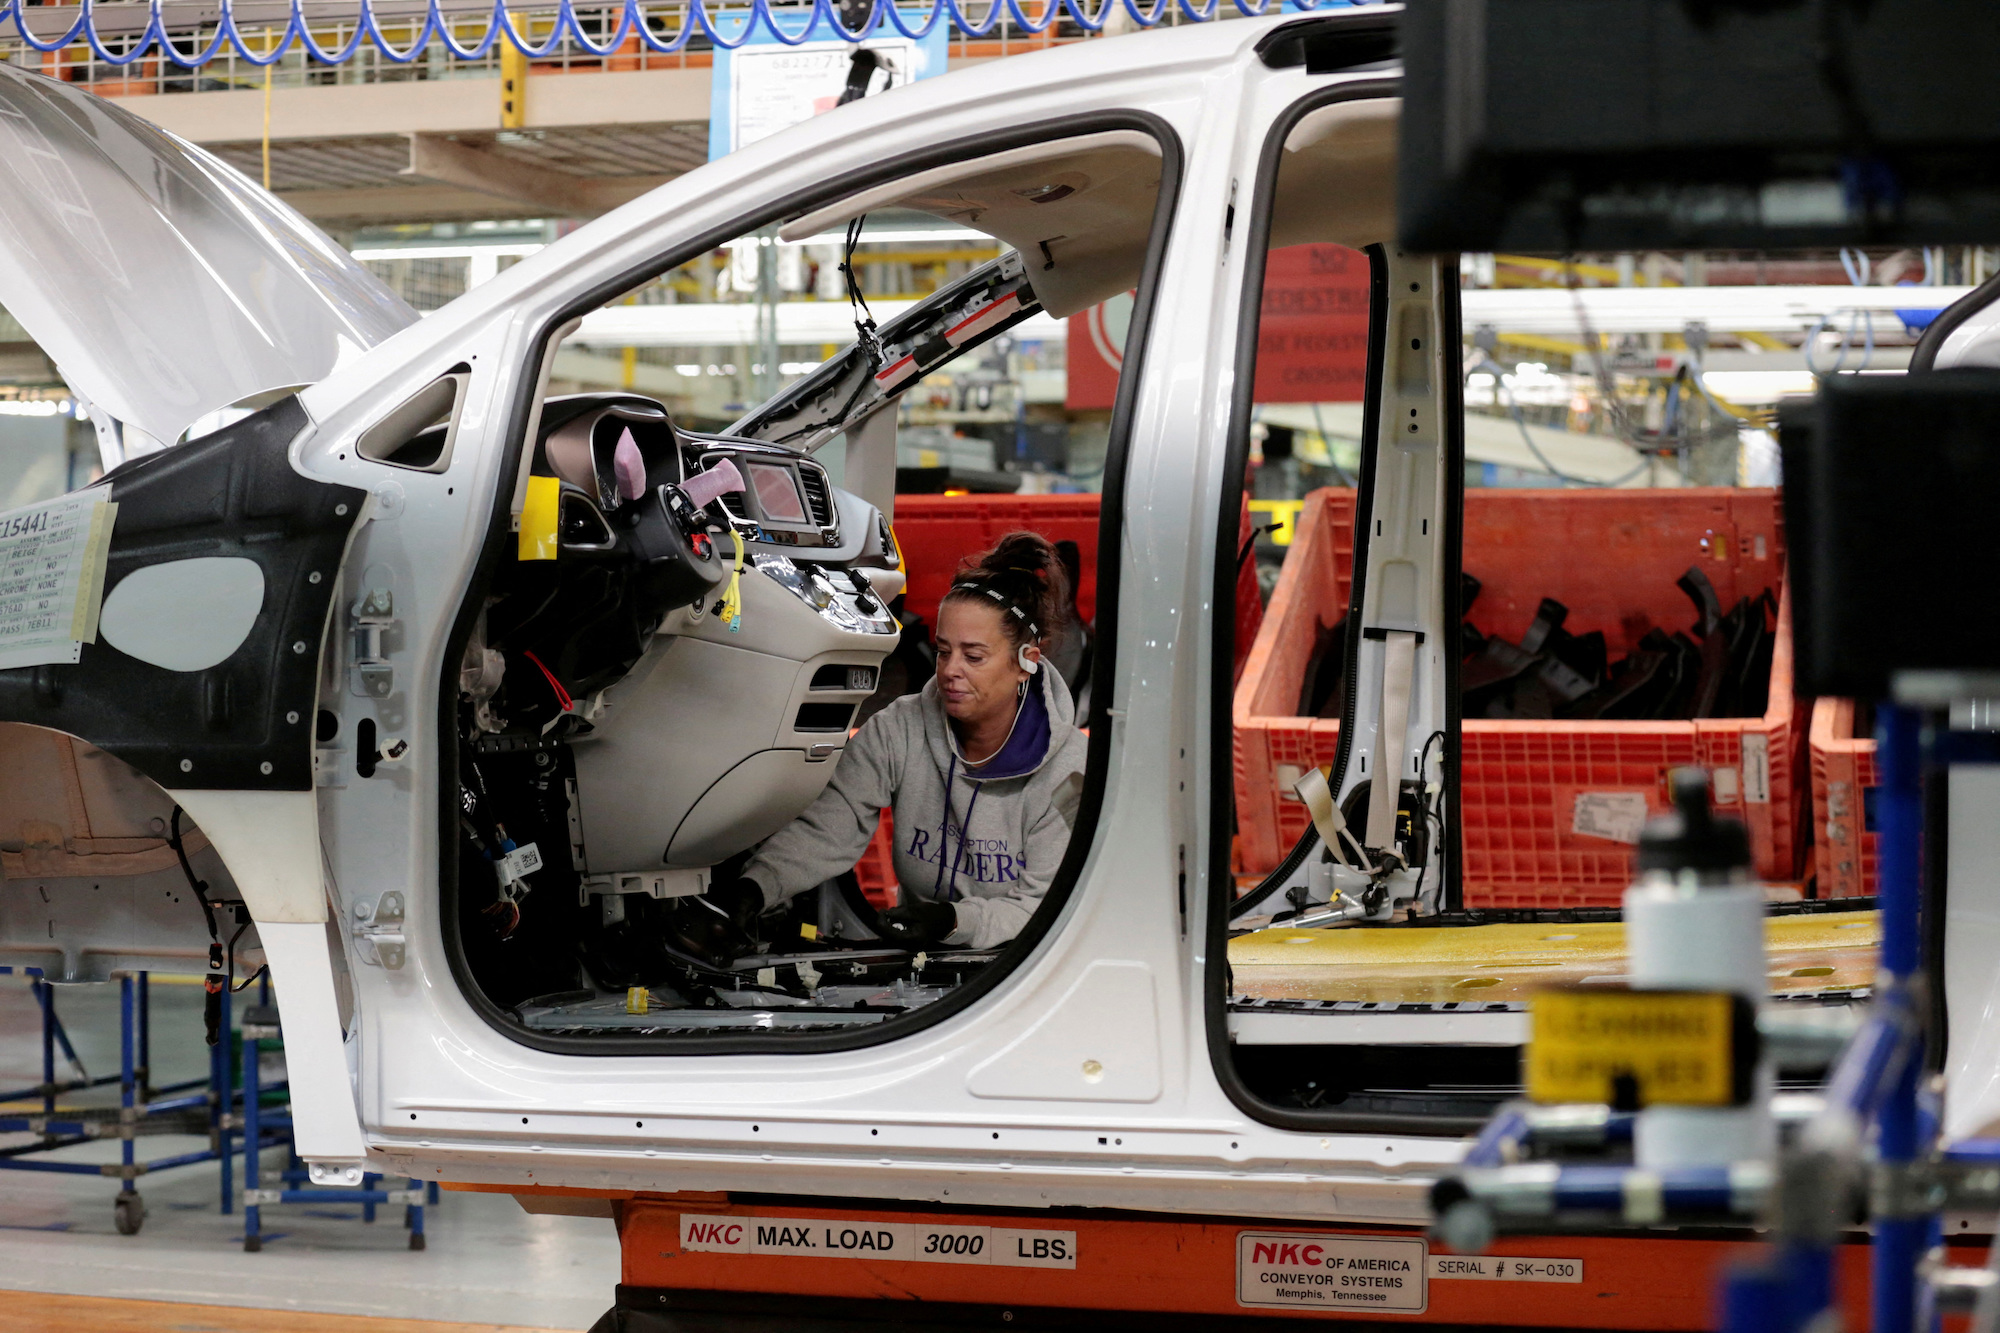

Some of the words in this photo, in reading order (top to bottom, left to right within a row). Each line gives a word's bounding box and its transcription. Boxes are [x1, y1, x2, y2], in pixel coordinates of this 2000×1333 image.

[12, 548, 37, 559] BEIGE
[46, 561, 57, 570] NO
[14, 567, 25, 577] NO
[0, 584, 28, 595] CHROME
[37, 579, 58, 590] NONE
[987, 589, 1005, 601] NIKE
[38, 599, 49, 610] NO
[1011, 606, 1026, 619] NIKE
[0, 625, 20, 635] PASS
[906, 826, 1027, 883] RADERS
[687, 1222, 743, 1245] NKC
[757, 1226, 817, 1248] MAX.
[826, 1229, 894, 1251] LOAD
[924, 1233, 984, 1255] 3000
[1018, 1237, 1073, 1260] LBS.
[1251, 1242, 1324, 1266] NKC
[1326, 1257, 1345, 1269] OF
[1347, 1258, 1410, 1272] AMERICA
[1438, 1260, 1486, 1275] SERIAL
[1515, 1262, 1574, 1277] SK-030
[1260, 1272, 1334, 1286] CONVEYOR
[1341, 1274, 1403, 1289] SYSTEMS
[1276, 1287, 1326, 1301] Memphis,
[1332, 1289, 1387, 1302] Tennessee
